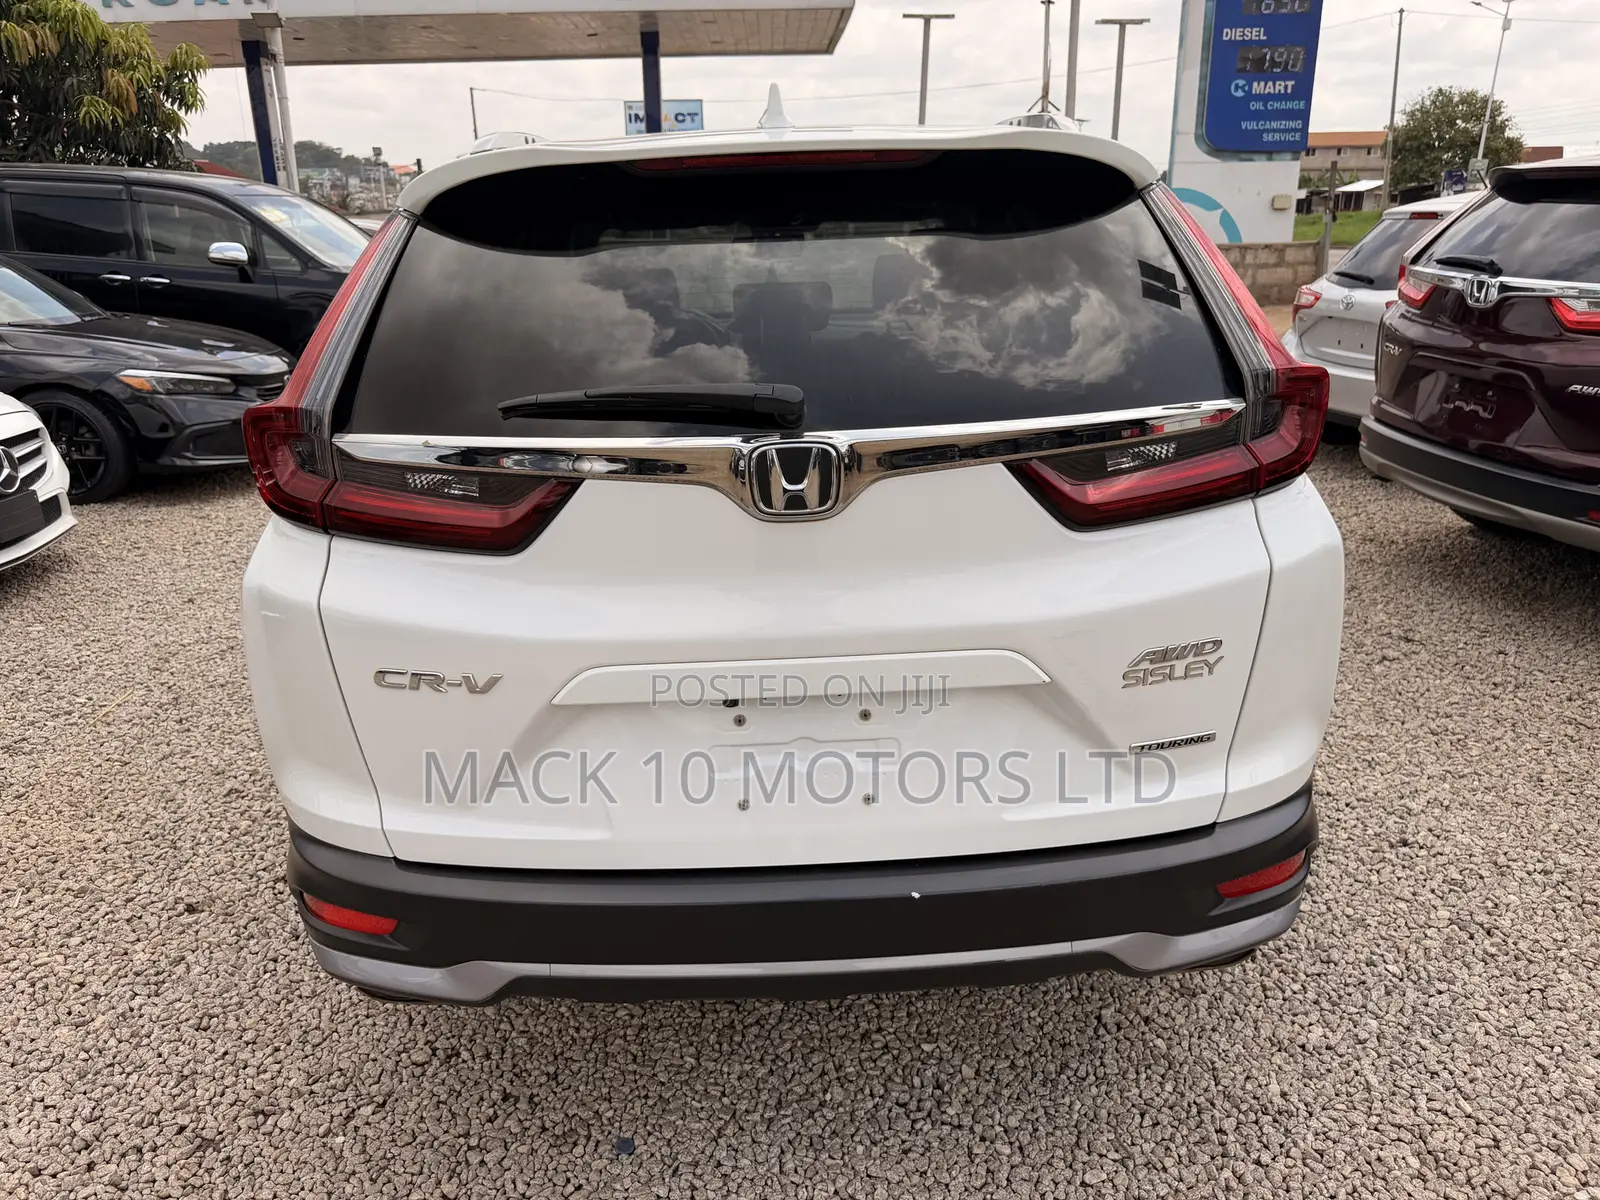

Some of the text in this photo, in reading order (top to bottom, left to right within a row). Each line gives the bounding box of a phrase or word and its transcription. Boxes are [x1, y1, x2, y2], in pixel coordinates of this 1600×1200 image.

[1222, 27, 1267, 41] DIESEL
[1252, 80, 1295, 95] MART
[1249, 100, 1306, 110] OIL CHANGE
[627, 112, 699, 125] IMACT
[1241, 119, 1303, 130] VULCANIZING
[1262, 132, 1301, 142] SERVICE
[1127, 636, 1223, 668] AWD
[1121, 655, 1225, 689] SISLEY
[373, 667, 504, 695] CR-V
[1137, 734, 1211, 752] TOURING
